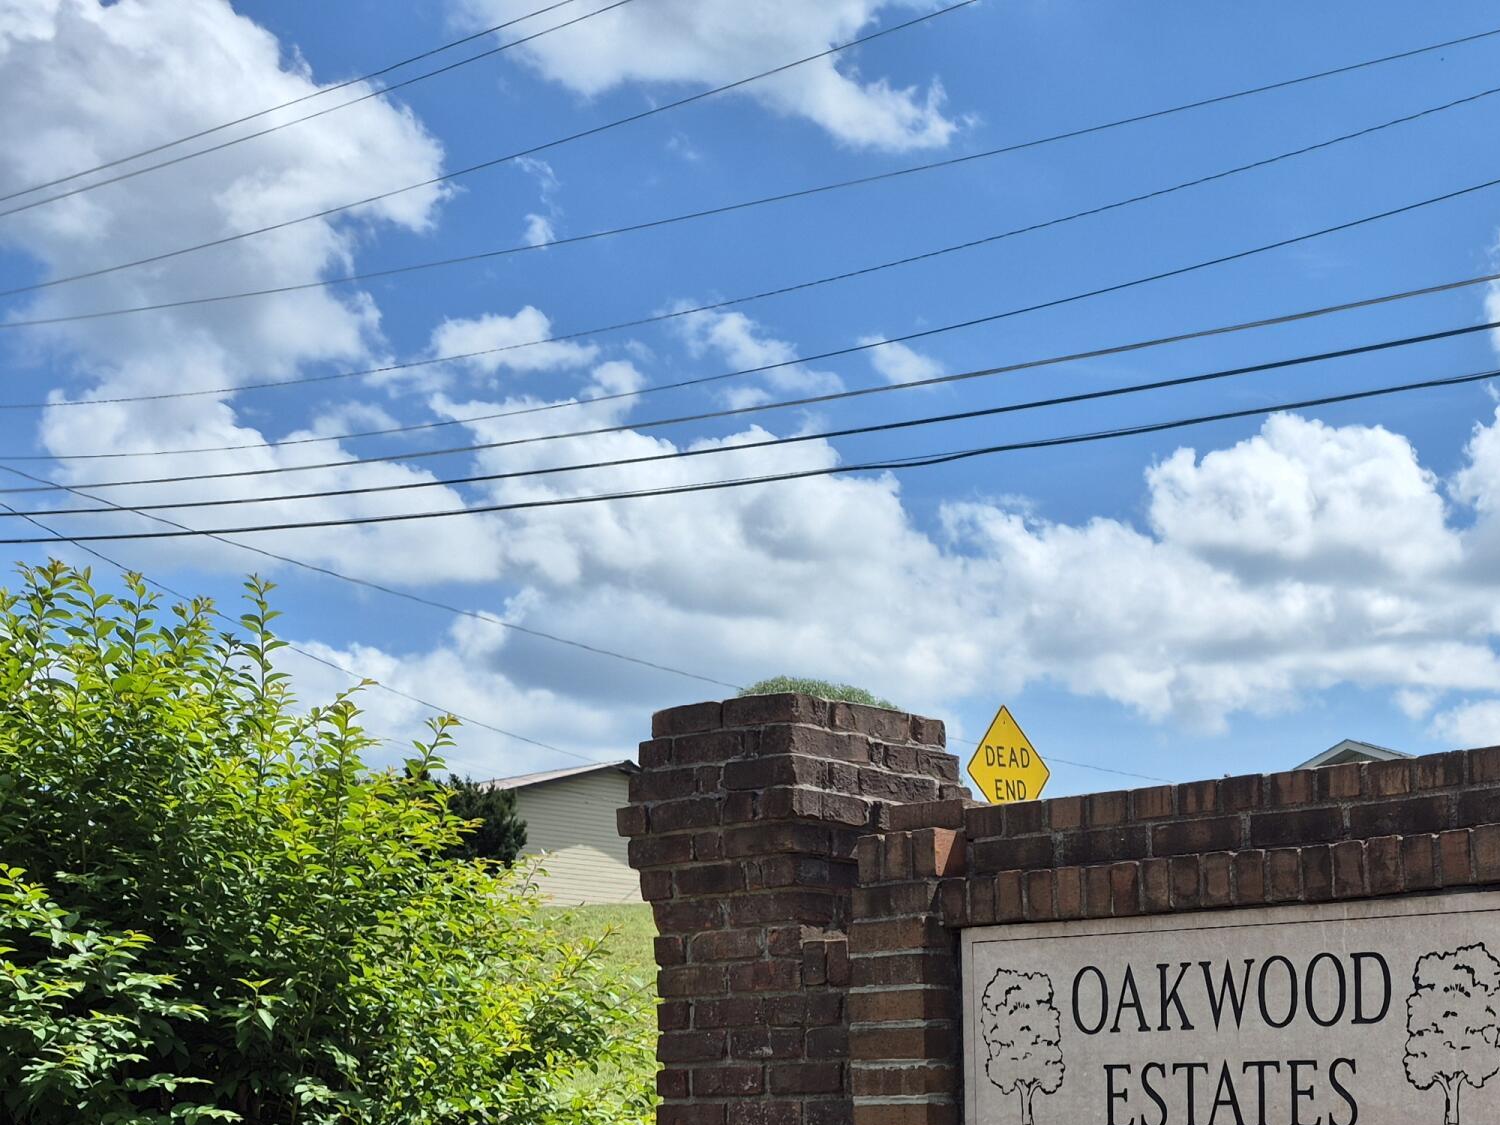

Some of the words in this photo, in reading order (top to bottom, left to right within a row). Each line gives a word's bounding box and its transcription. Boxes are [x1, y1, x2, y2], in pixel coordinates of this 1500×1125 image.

[985, 745, 1030, 768] DEAD
[995, 778, 1026, 801] END
[1071, 951, 1392, 1035] OAKWOOD
